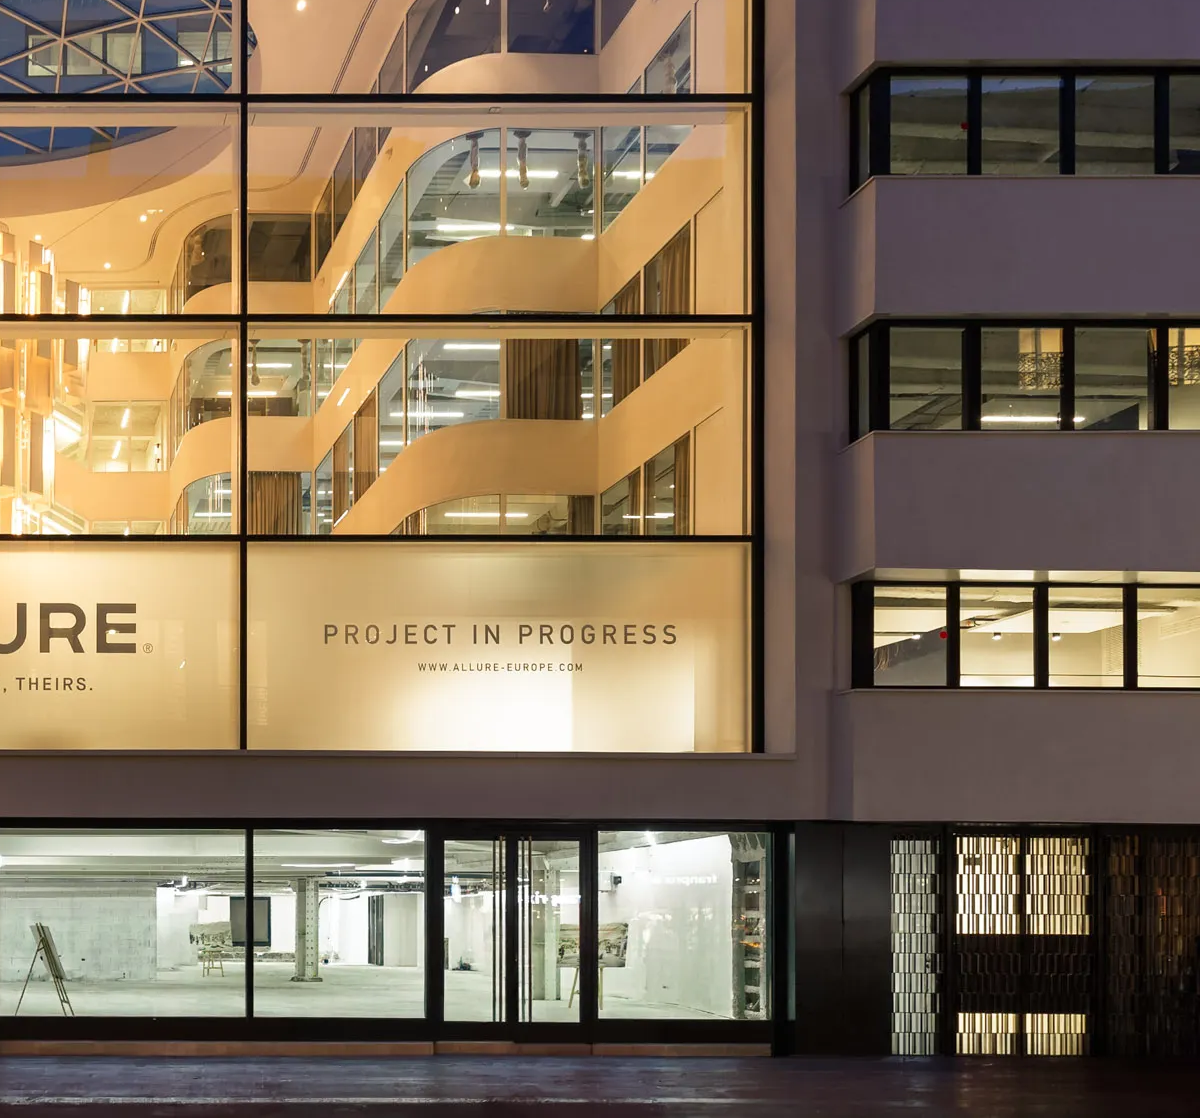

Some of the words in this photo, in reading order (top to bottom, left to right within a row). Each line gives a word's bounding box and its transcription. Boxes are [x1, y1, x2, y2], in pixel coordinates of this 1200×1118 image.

[324, 624, 456, 645] PROJECT
[472, 624, 501, 645] IN
[519, 624, 678, 645] PROGRESS
[417, 662, 584, 672] WWW.ALLURE-EUROPE.COM
[16, 677, 93, 691] THEIRS.
